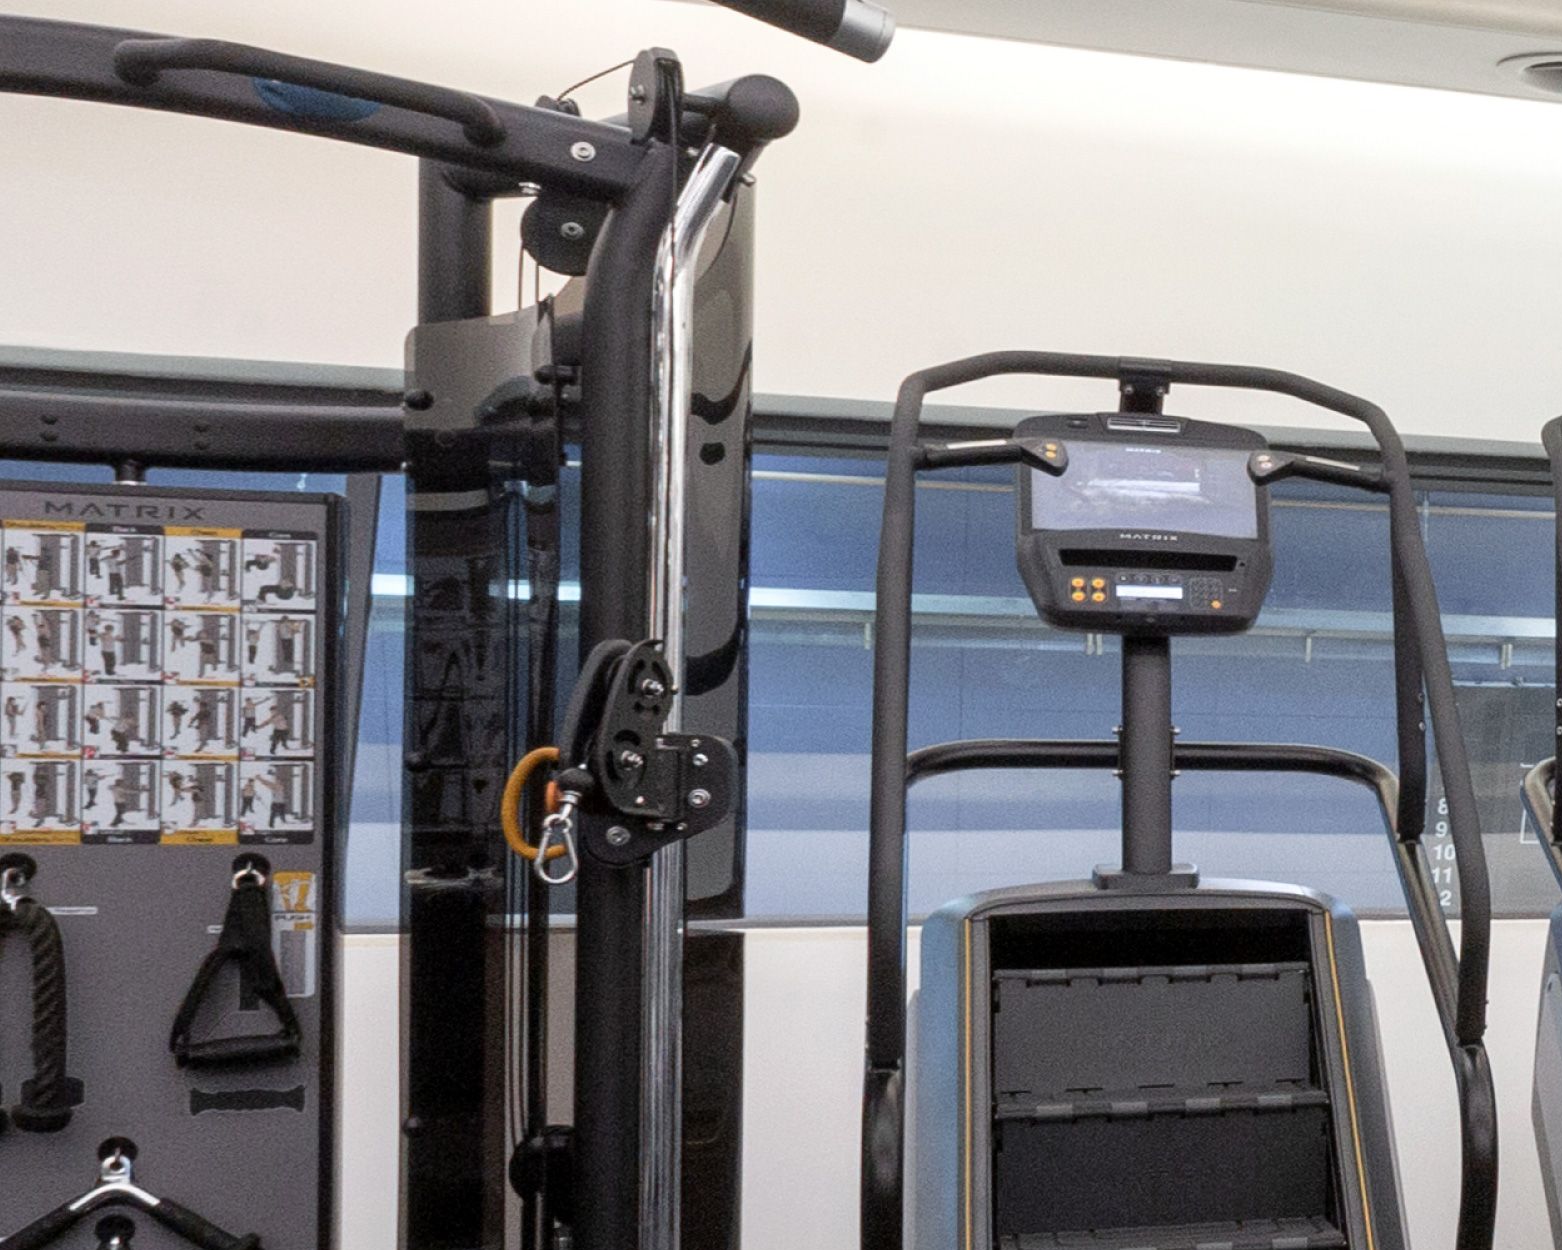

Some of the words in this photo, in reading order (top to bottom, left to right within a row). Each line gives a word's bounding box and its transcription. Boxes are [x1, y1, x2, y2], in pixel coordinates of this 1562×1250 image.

[44, 500, 206, 521] MATRIX
[1119, 532, 1179, 542] MATRIX
[1434, 821, 1449, 839] 9
[1432, 843, 1457, 861] 10
[1430, 866, 1454, 884] 11
